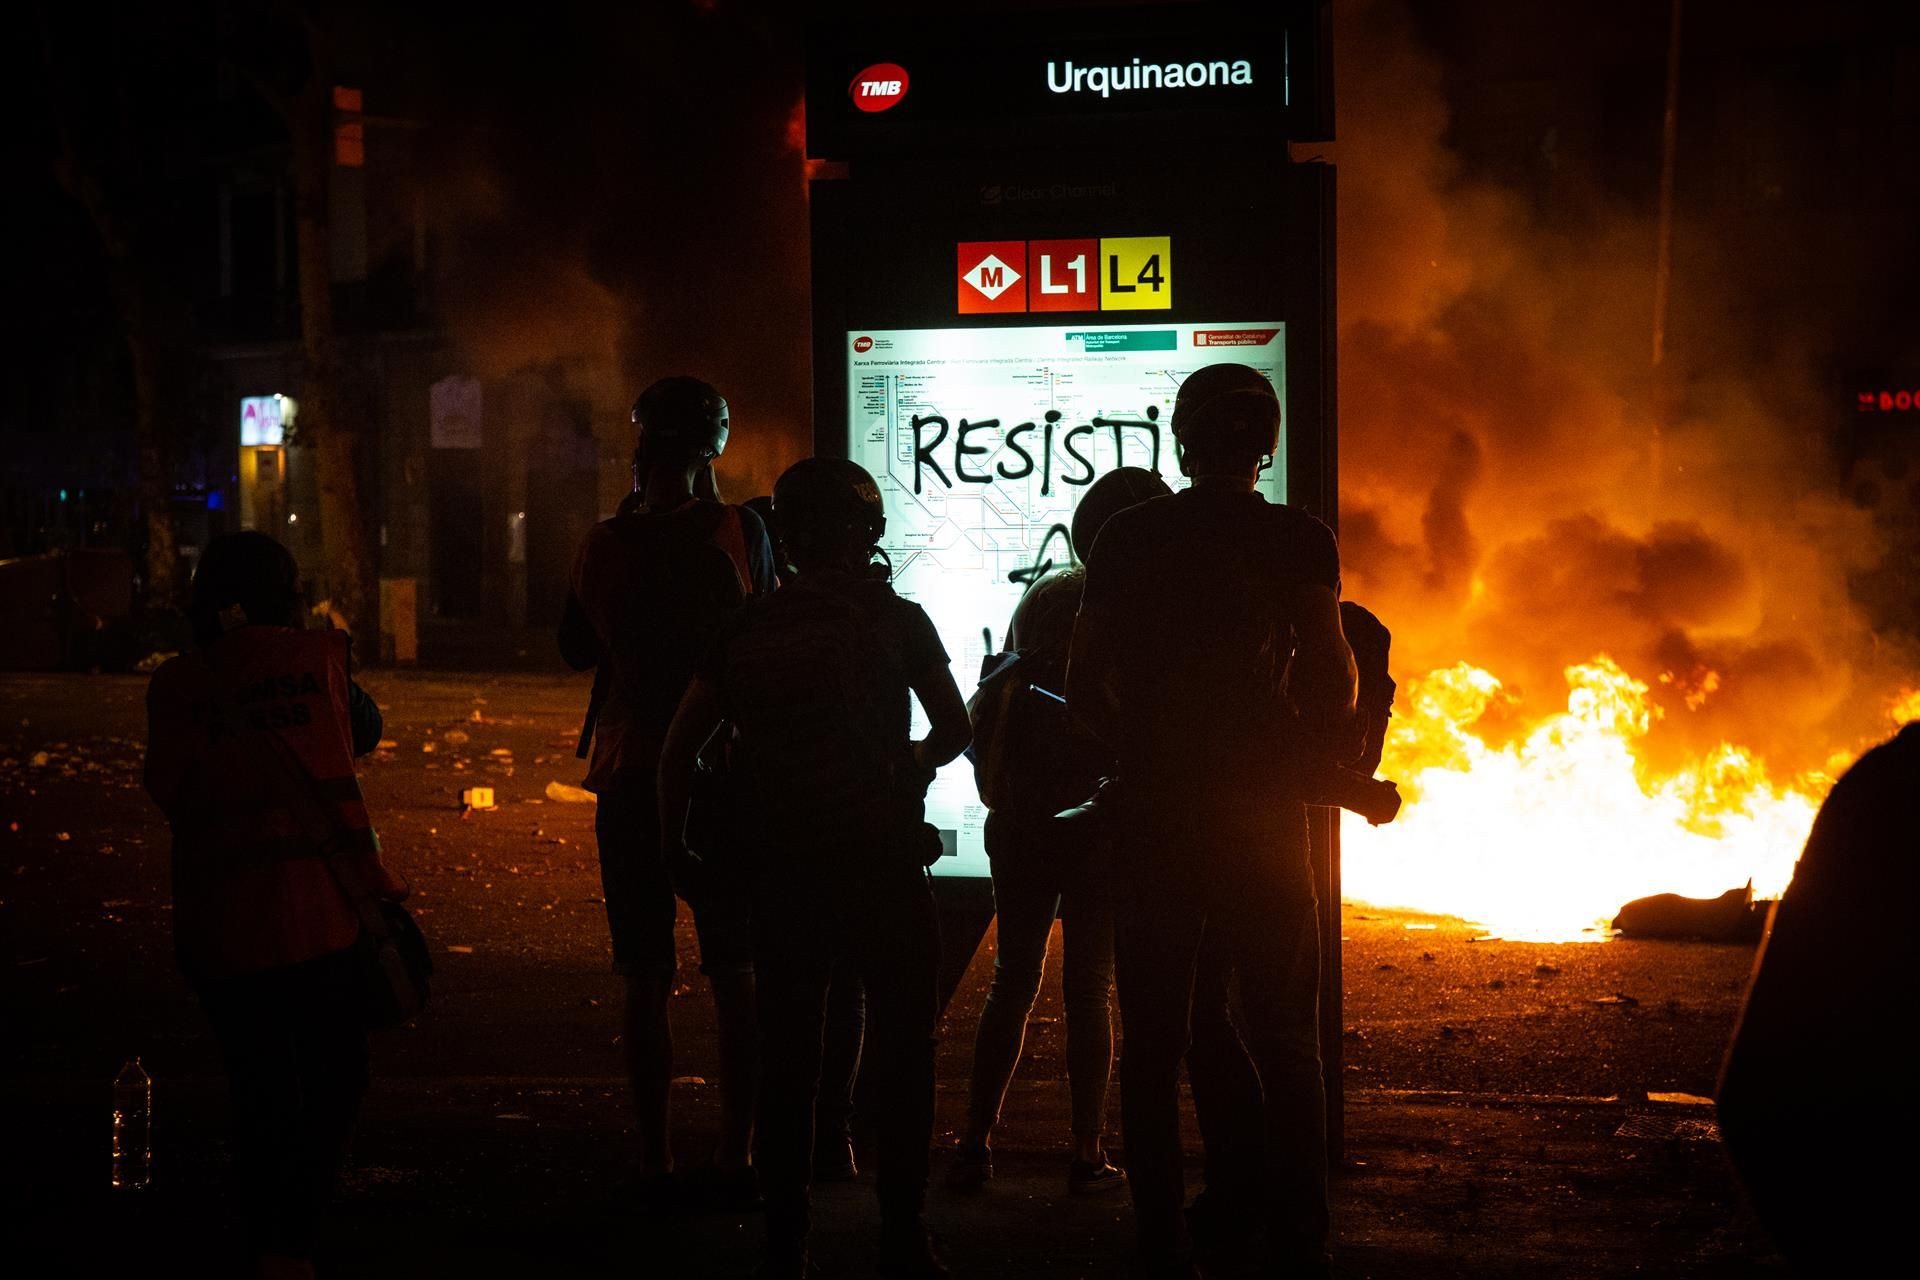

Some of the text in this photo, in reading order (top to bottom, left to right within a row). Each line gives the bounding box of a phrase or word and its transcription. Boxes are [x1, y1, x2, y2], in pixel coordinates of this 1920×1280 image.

[860, 79, 902, 97] TMB
[1047, 57, 1253, 98] Urquinaona
[981, 266, 1003, 288] M
[1039, 254, 1087, 294] L1
[1108, 255, 1165, 293] L4
[911, 404, 1182, 498] RESISTI
